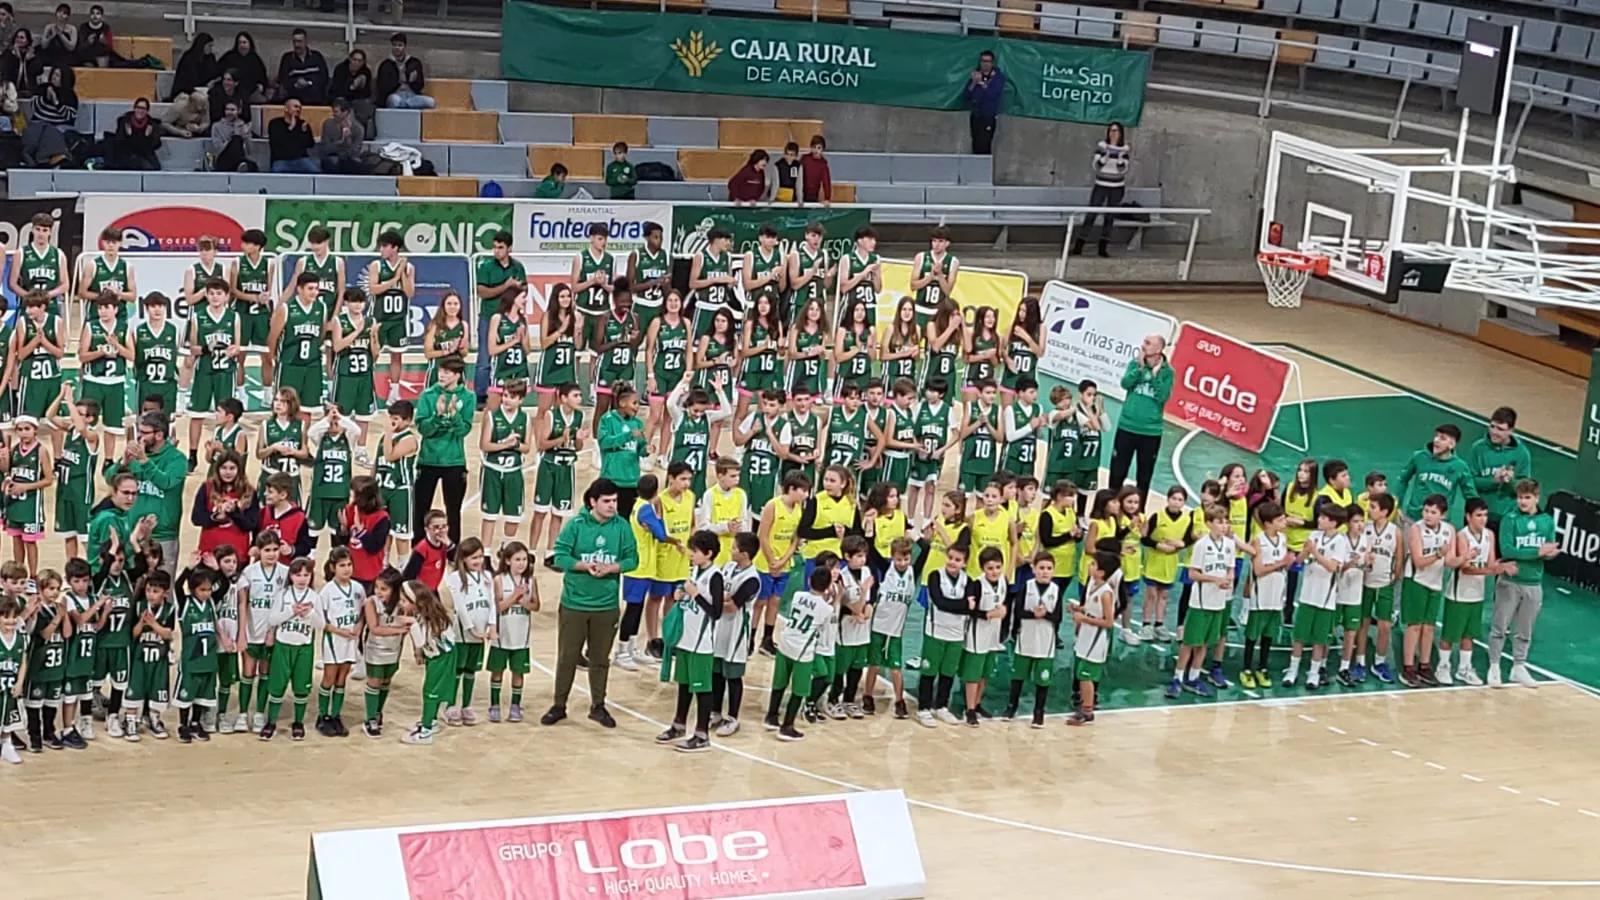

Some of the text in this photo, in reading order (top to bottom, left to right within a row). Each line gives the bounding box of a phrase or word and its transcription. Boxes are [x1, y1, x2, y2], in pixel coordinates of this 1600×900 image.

[730, 38, 877, 68] CAJA RURAL
[746, 66, 860, 88] DE ARAGÓN
[1078, 66, 1114, 88] San
[1042, 82, 1113, 104] Lorenzo
[530, 212, 646, 239] Fontecbra
[384, 295, 404, 314] 00
[588, 287, 605, 305] 14
[1083, 328, 1115, 351] rivas
[1196, 340, 1221, 356] GRUPO
[300, 340, 310, 359] 8
[506, 348, 522, 364] 33
[555, 348, 570, 365] 31
[30, 359, 52, 379] 20
[105, 360, 117, 377] 2
[146, 363, 167, 381] 99
[349, 354, 368, 373] 33
[761, 354, 774, 371] 16
[804, 360, 819, 376] 15
[852, 358, 866, 374] 13
[899, 359, 912, 375] 12
[941, 357, 949, 374] 8
[979, 363, 989, 379] 5
[1183, 366, 1257, 414] Lobe
[975, 439, 991, 458] 10
[1019, 444, 1035, 462] 31
[1063, 443, 1073, 457] 3
[1083, 441, 1099, 457] 77
[685, 450, 703, 471] 41
[749, 455, 771, 475] 33
[323, 464, 344, 483] 32
[1552, 506, 1600, 565] Hue
[798, 595, 817, 611] IAN
[109, 613, 127, 632] 17
[786, 606, 814, 635] 54
[200, 638, 208, 656] 1
[45, 647, 63, 668] 33
[498, 841, 562, 862] GRUPO
[573, 823, 769, 875] Lobe
[604, 869, 758, 896] HIGH QUALITY HOMES
